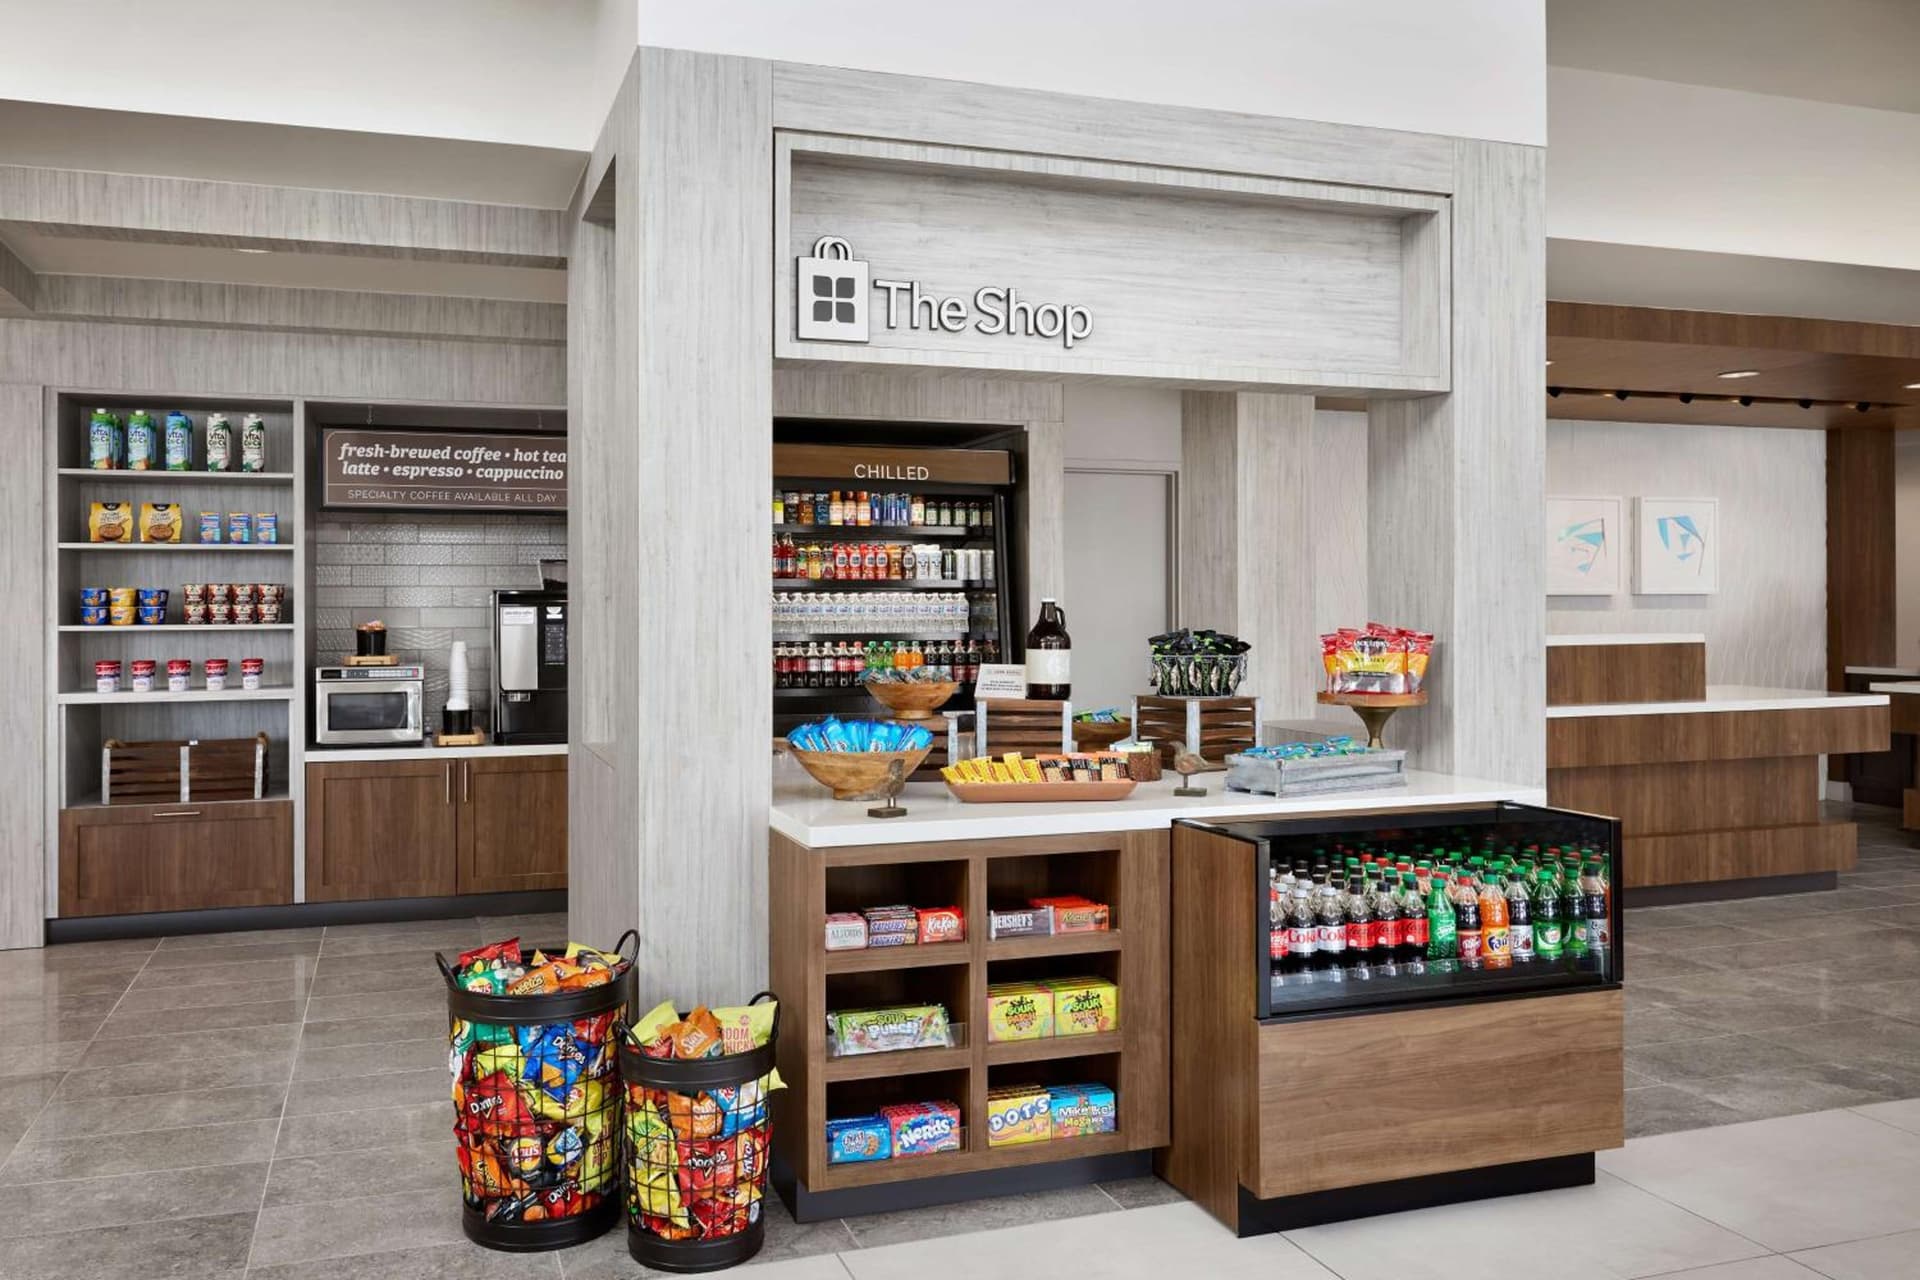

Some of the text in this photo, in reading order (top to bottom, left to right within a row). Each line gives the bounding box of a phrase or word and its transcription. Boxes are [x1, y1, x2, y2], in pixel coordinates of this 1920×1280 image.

[873, 279, 1094, 349] The Shop
[338, 443, 567, 464] fresh-brewed coffee hot tea
[342, 461, 564, 482] latte espresso cappuccino
[853, 463, 929, 481] CHILLED
[347, 489, 558, 503] SPECIALTY COFFEE AVAILABLE ALL DAY
[989, 1098, 1049, 1132] DOTS
